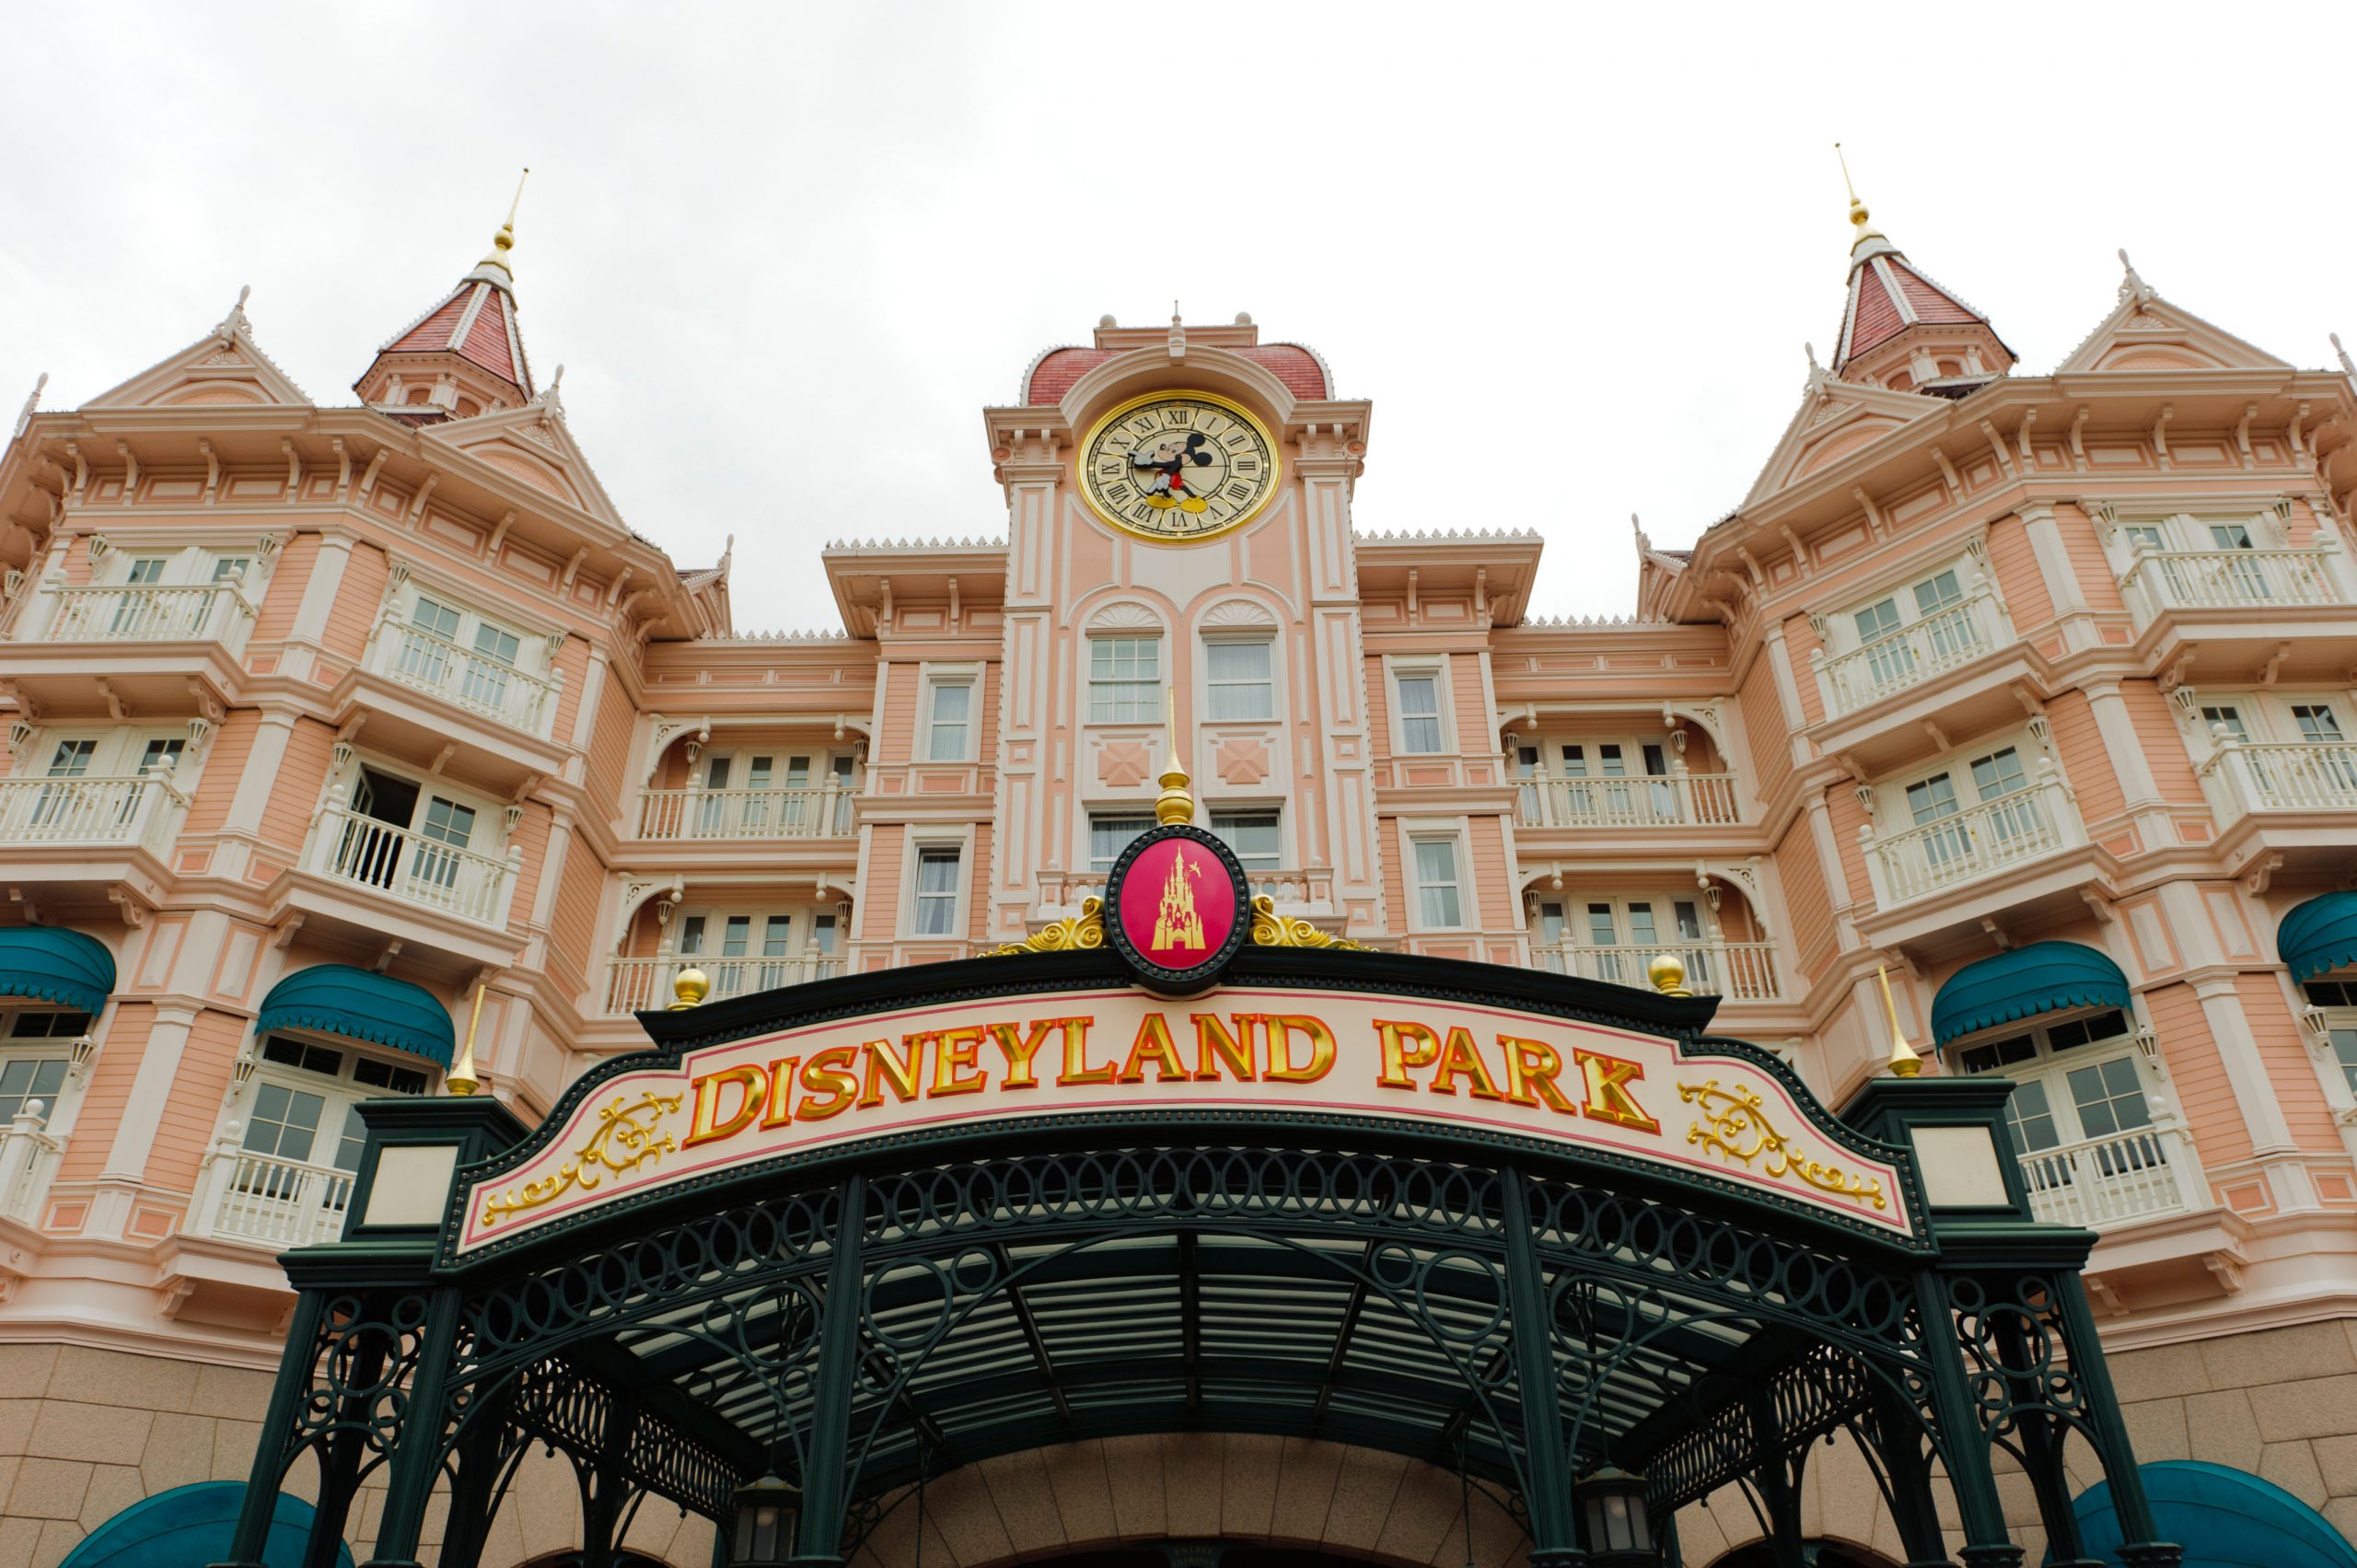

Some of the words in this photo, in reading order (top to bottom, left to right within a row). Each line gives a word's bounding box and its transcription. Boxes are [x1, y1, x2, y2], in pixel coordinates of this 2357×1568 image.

[1134, 416, 1155, 433] XI
[1168, 411, 1188, 424] XII
[1206, 417, 1217, 430] I
[1110, 437, 1131, 449] X
[1227, 435, 1246, 447] II
[1101, 463, 1120, 474] IX
[1237, 461, 1256, 471] III
[1107, 483, 1131, 505] VIII
[1226, 483, 1250, 500] IIII
[1132, 504, 1154, 523] VII
[1209, 505, 1224, 519] V
[1172, 512, 1188, 527] VI
[681, 1012, 1337, 1150] DISNEYLAND
[1373, 1018, 1662, 1135] PARK
